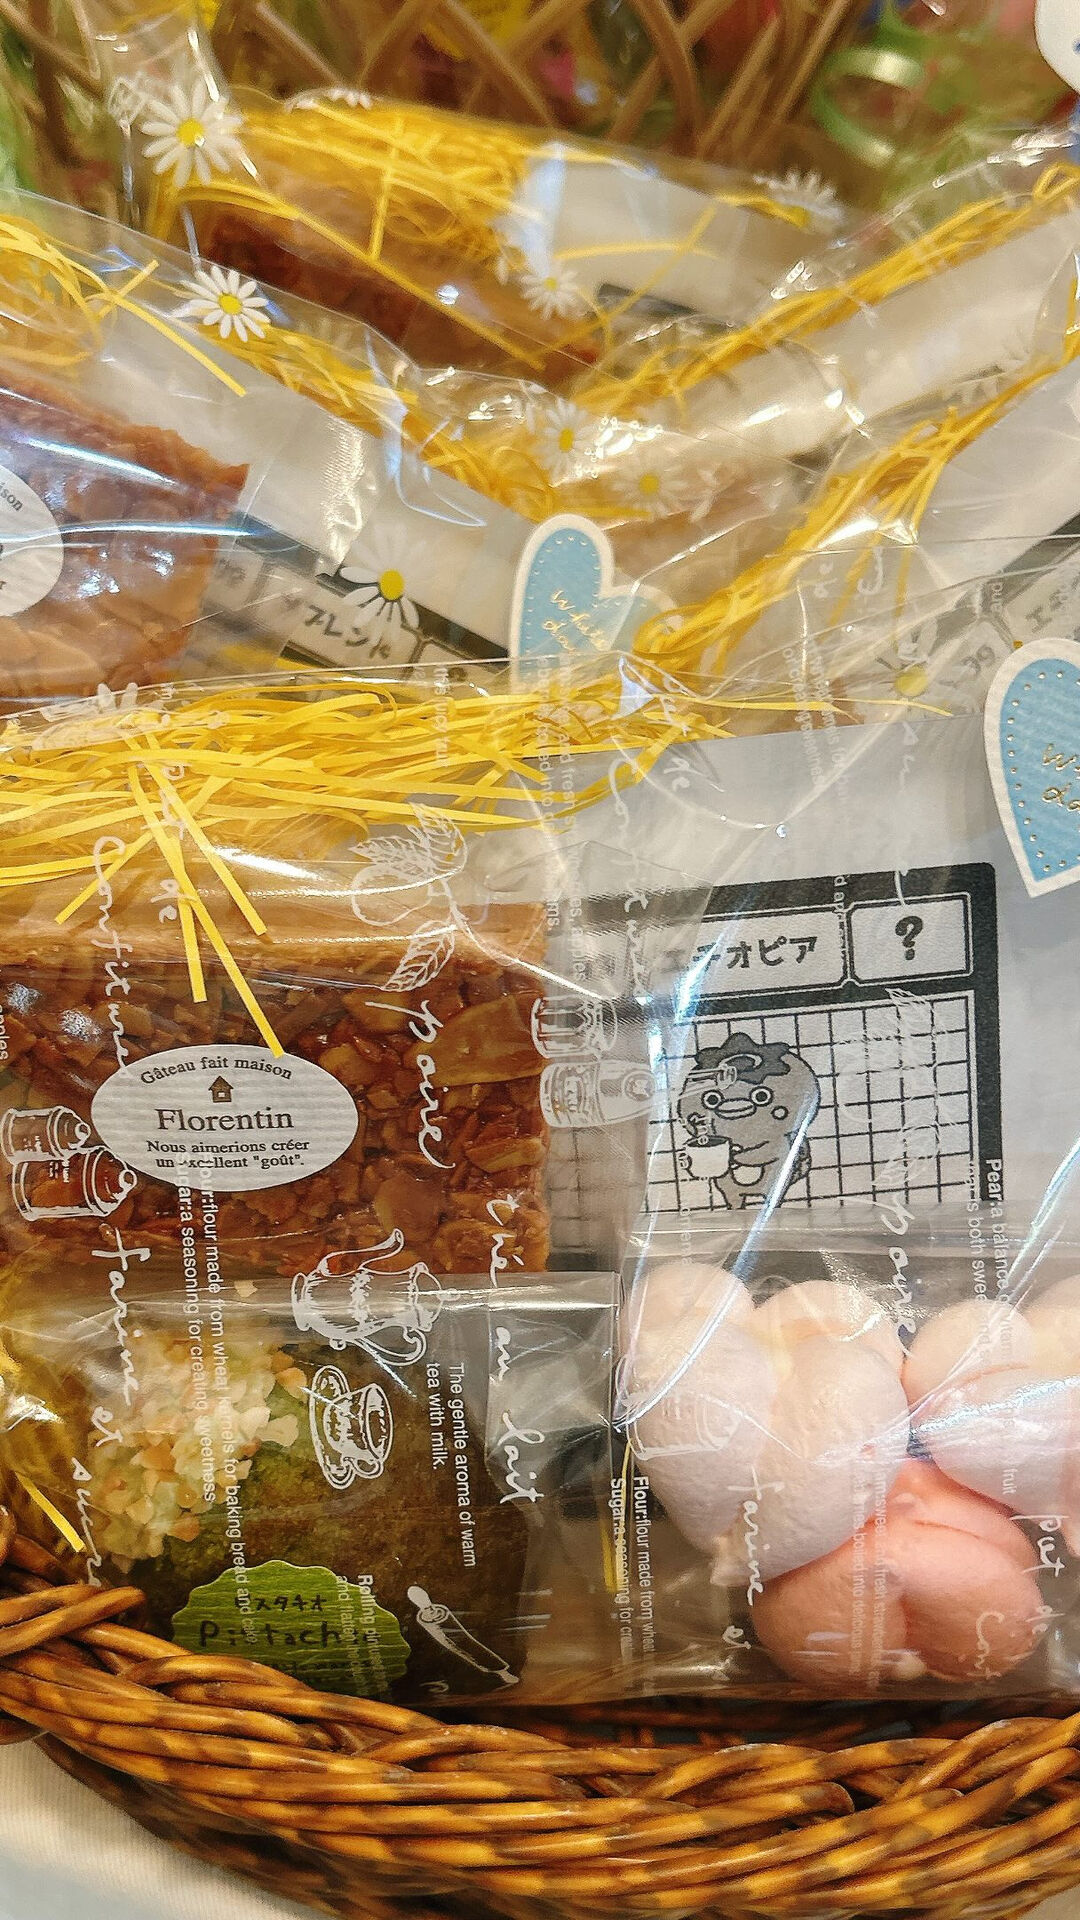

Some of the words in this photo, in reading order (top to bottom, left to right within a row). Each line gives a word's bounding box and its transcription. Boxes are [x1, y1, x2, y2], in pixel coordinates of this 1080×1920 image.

[140, 1061, 196, 1085] Gâteau
[200, 1056, 229, 1071] fait
[235, 1058, 294, 1080] maison
[155, 1106, 294, 1132] Florentin
[146, 1140, 186, 1154] Nous
[191, 1142, 266, 1154] aimerions
[271, 1139, 310, 1153] créer
[156, 1158, 175, 1169] un
[967, 1216, 984, 1256] both
[181, 1225, 203, 1313] seasoning
[206, 1246, 225, 1293] made
[189, 1318, 205, 1341] for
[209, 1298, 228, 1337] from
[212, 1341, 231, 1391] wheat
[426, 1362, 441, 1388] tea
[449, 1363, 466, 1394] The
[429, 1393, 446, 1427] with
[446, 1397, 470, 1450] gentle
[200, 1414, 218, 1502] sweetness
[431, 1431, 448, 1470] milk.
[497, 1411, 545, 1504] lait
[223, 1458, 240, 1482] for
[454, 1454, 473, 1506] aroma
[1002, 1468, 1018, 1495] fruit
[225, 1485, 247, 1538] baking
[459, 1510, 476, 1526] of
[631, 1475, 652, 1548] Flour:flour
[231, 1542, 250, 1584] bread
[461, 1529, 477, 1568] warm
[638, 1551, 653, 1587] made
[236, 1588, 253, 1615] and
[337, 1575, 352, 1602] and
[356, 1574, 379, 1625] Rolling
[640, 1590, 656, 1620] from
[619, 1607, 635, 1625] for
